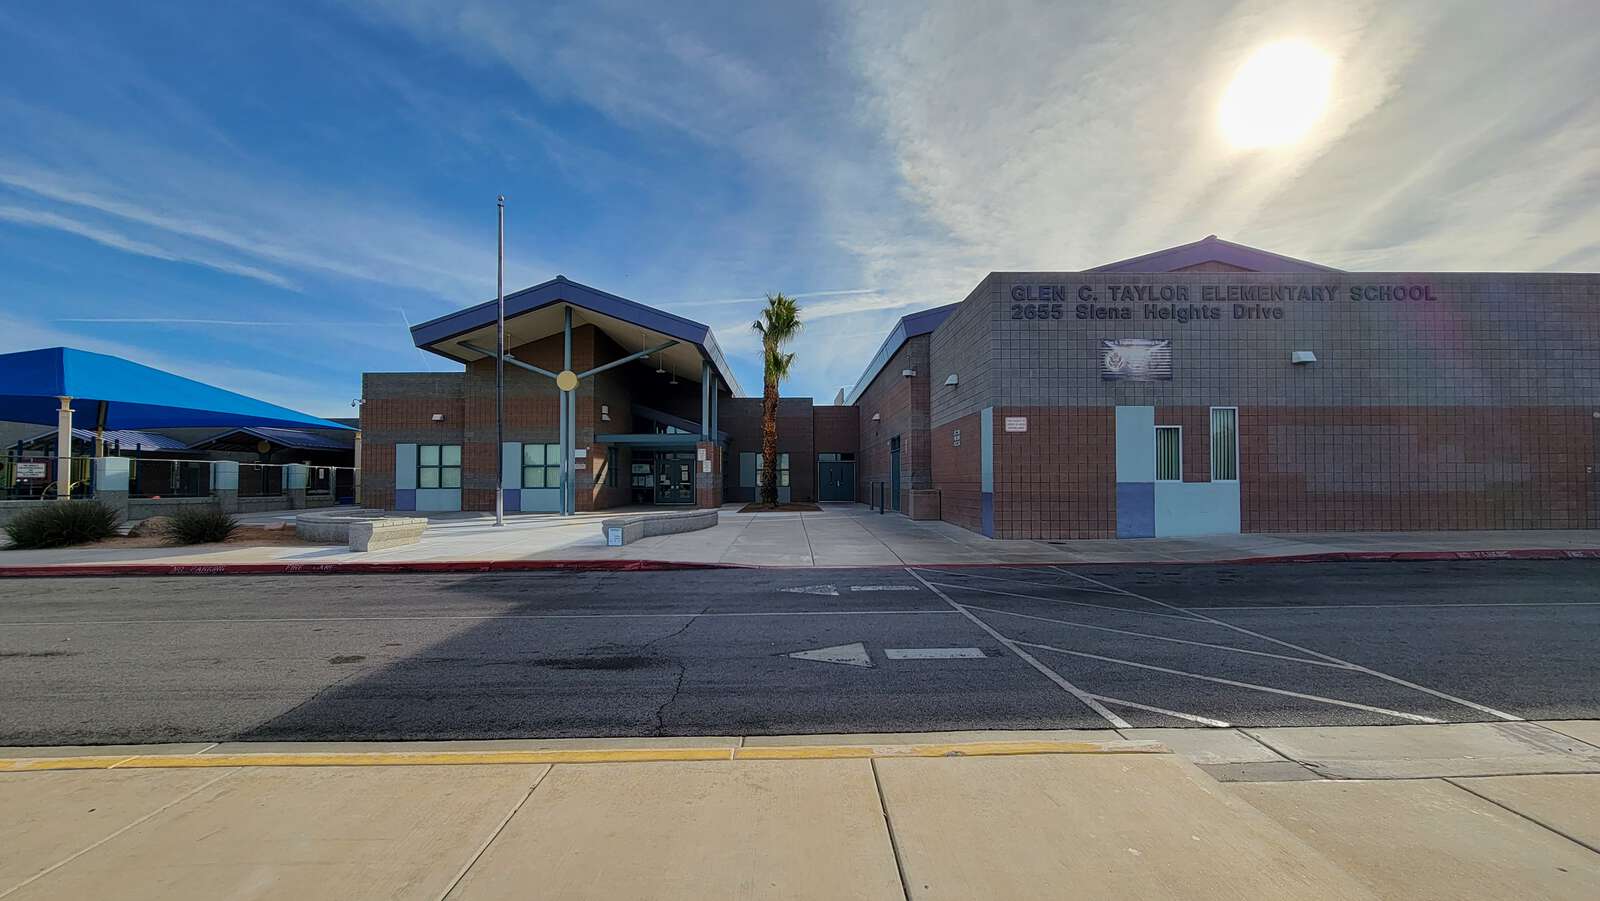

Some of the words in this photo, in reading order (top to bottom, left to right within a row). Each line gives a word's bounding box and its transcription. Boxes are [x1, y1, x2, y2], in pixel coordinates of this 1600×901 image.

[1011, 285, 1065, 301] GLEN
[1078, 285, 1098, 301] C.
[1108, 285, 1189, 301] TAYLOR
[1201, 285, 1337, 301] ELEMENTARY
[1350, 285, 1437, 301] SCHOOL
[1011, 303, 1064, 320] 2655
[1075, 303, 1132, 320] Siena
[1144, 303, 1221, 323] Heights
[1233, 303, 1283, 320] Drive
